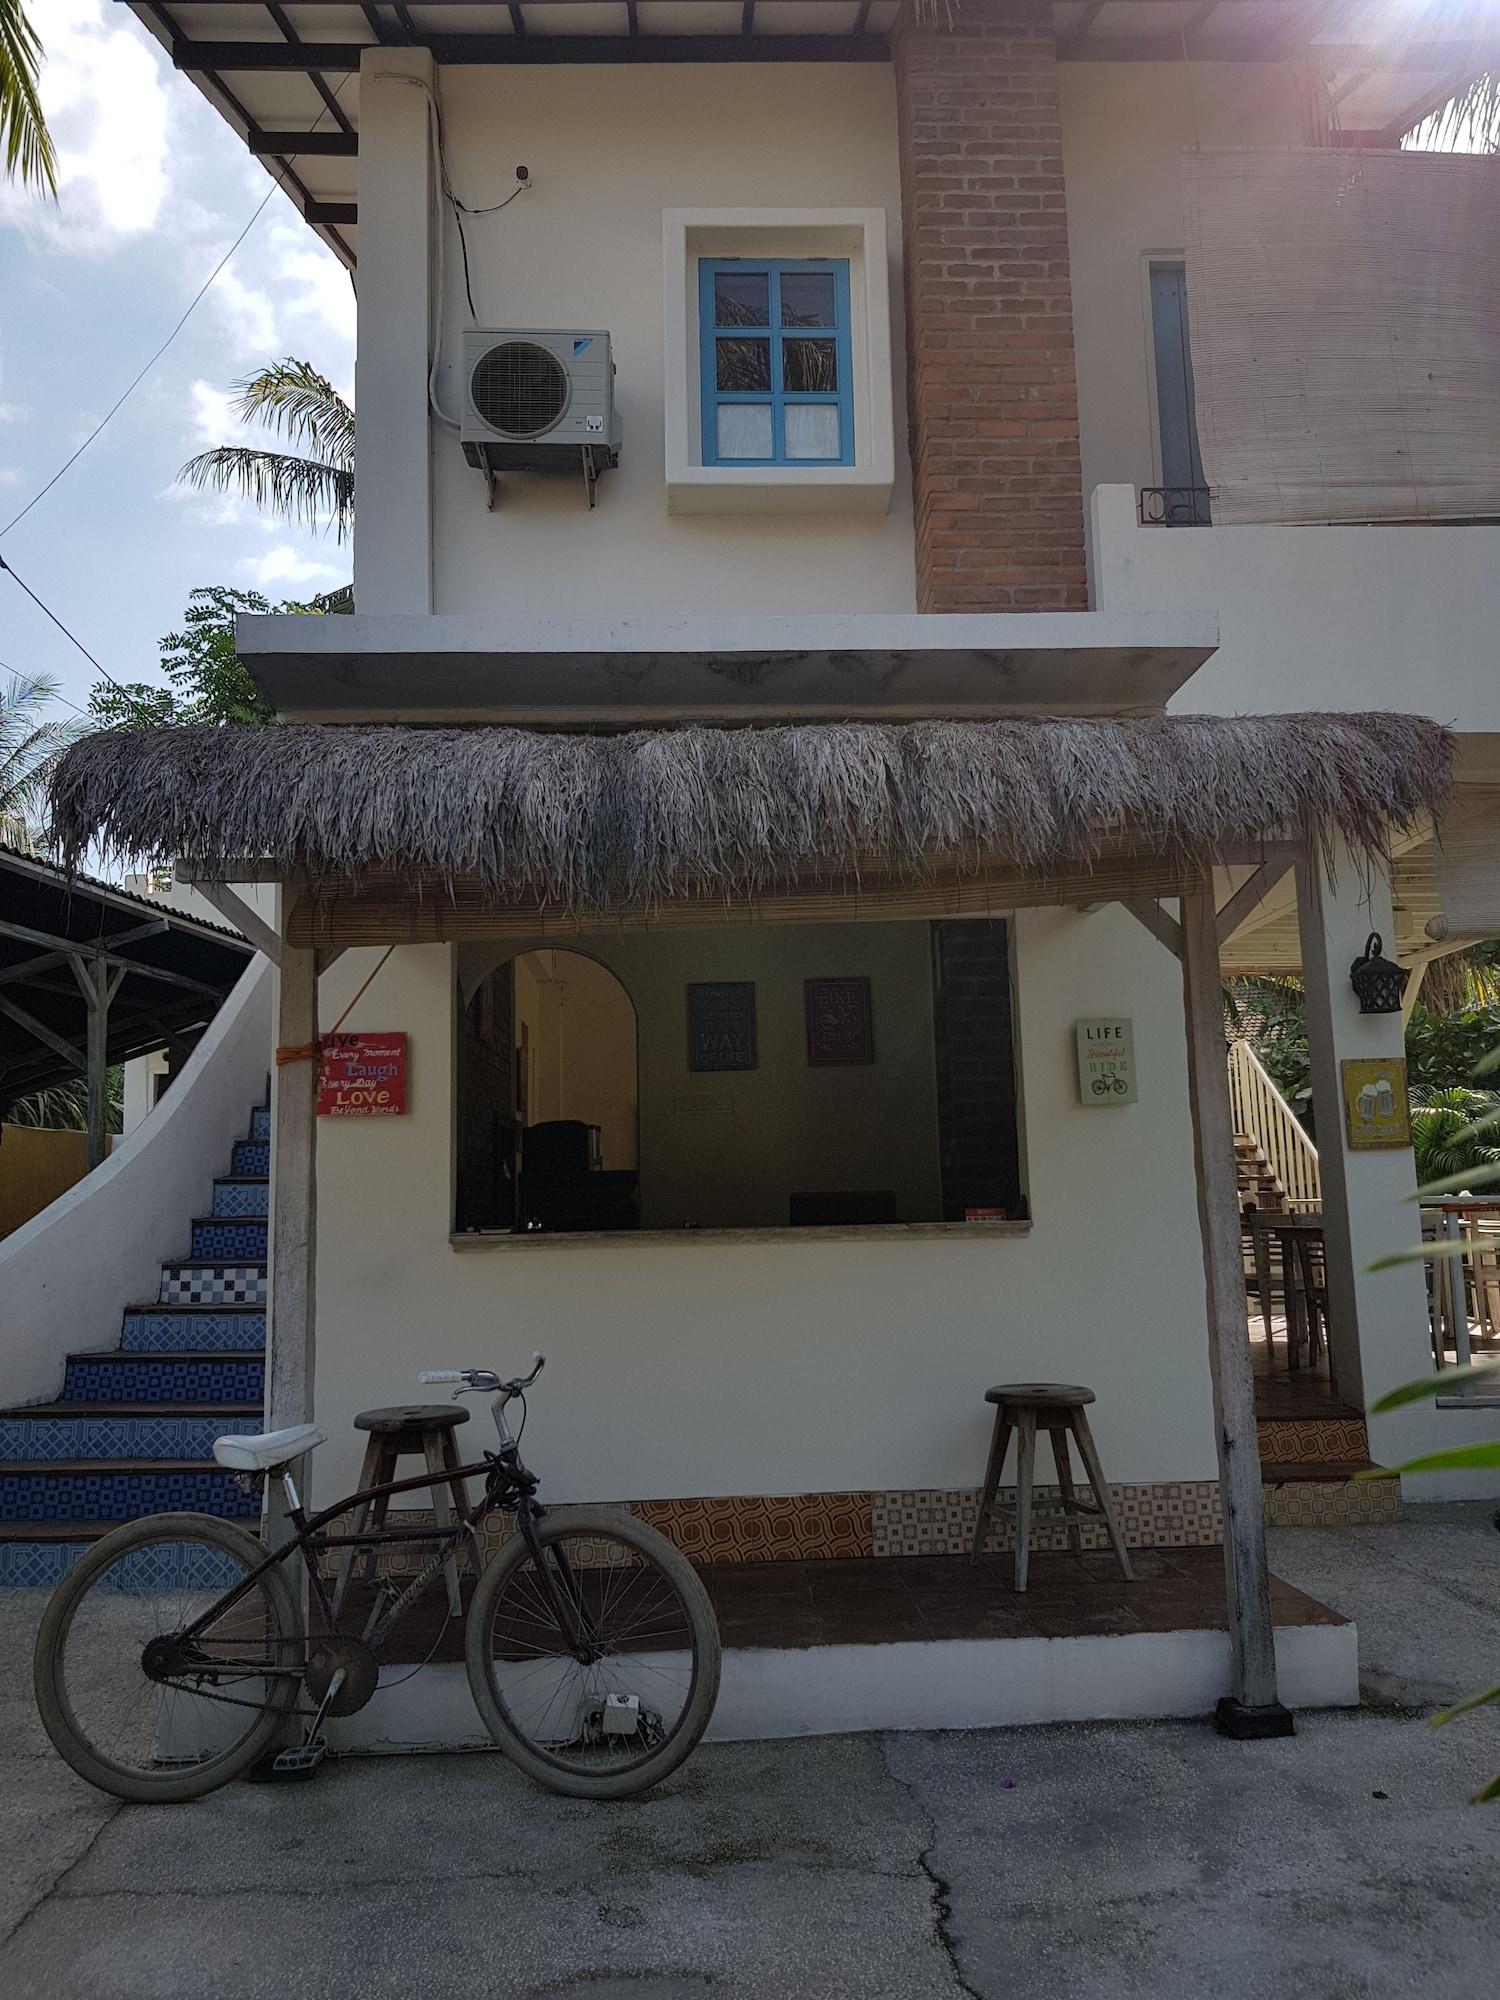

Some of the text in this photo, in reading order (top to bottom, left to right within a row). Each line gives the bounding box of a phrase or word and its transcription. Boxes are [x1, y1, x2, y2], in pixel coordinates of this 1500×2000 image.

[1086, 1027, 1122, 1040] LIFE
[700, 1032, 744, 1051] WAY
[346, 1063, 398, 1081] Laugh
[1088, 1061, 1127, 1073] RIDE
